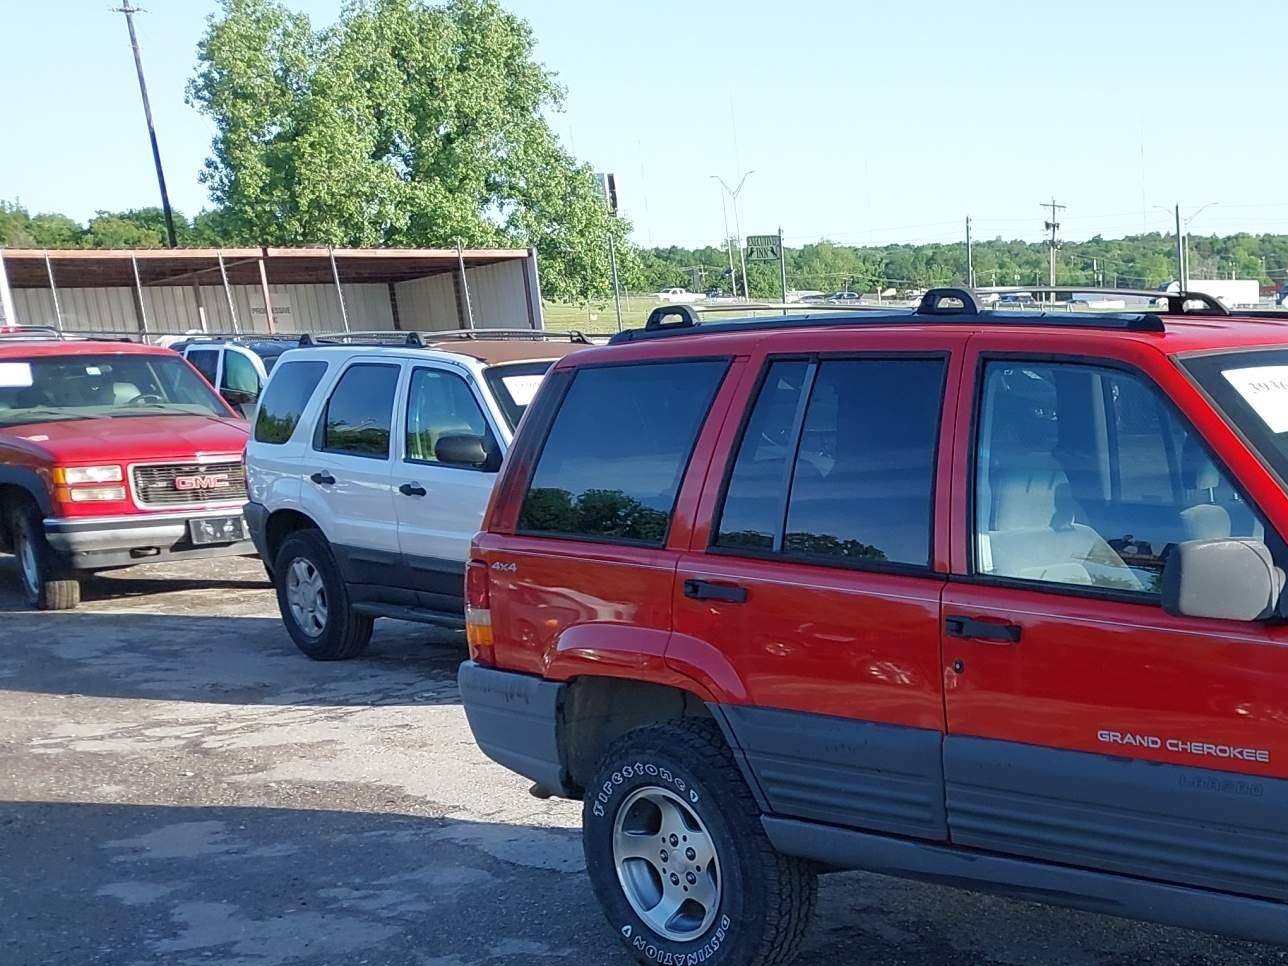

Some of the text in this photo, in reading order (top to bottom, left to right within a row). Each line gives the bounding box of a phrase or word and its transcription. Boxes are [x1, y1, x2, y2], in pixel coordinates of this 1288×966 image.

[176, 474, 230, 491] GMC
[1097, 729, 1270, 763] GRAND CHEROKEE
[631, 913, 731, 966] DESTINATION
